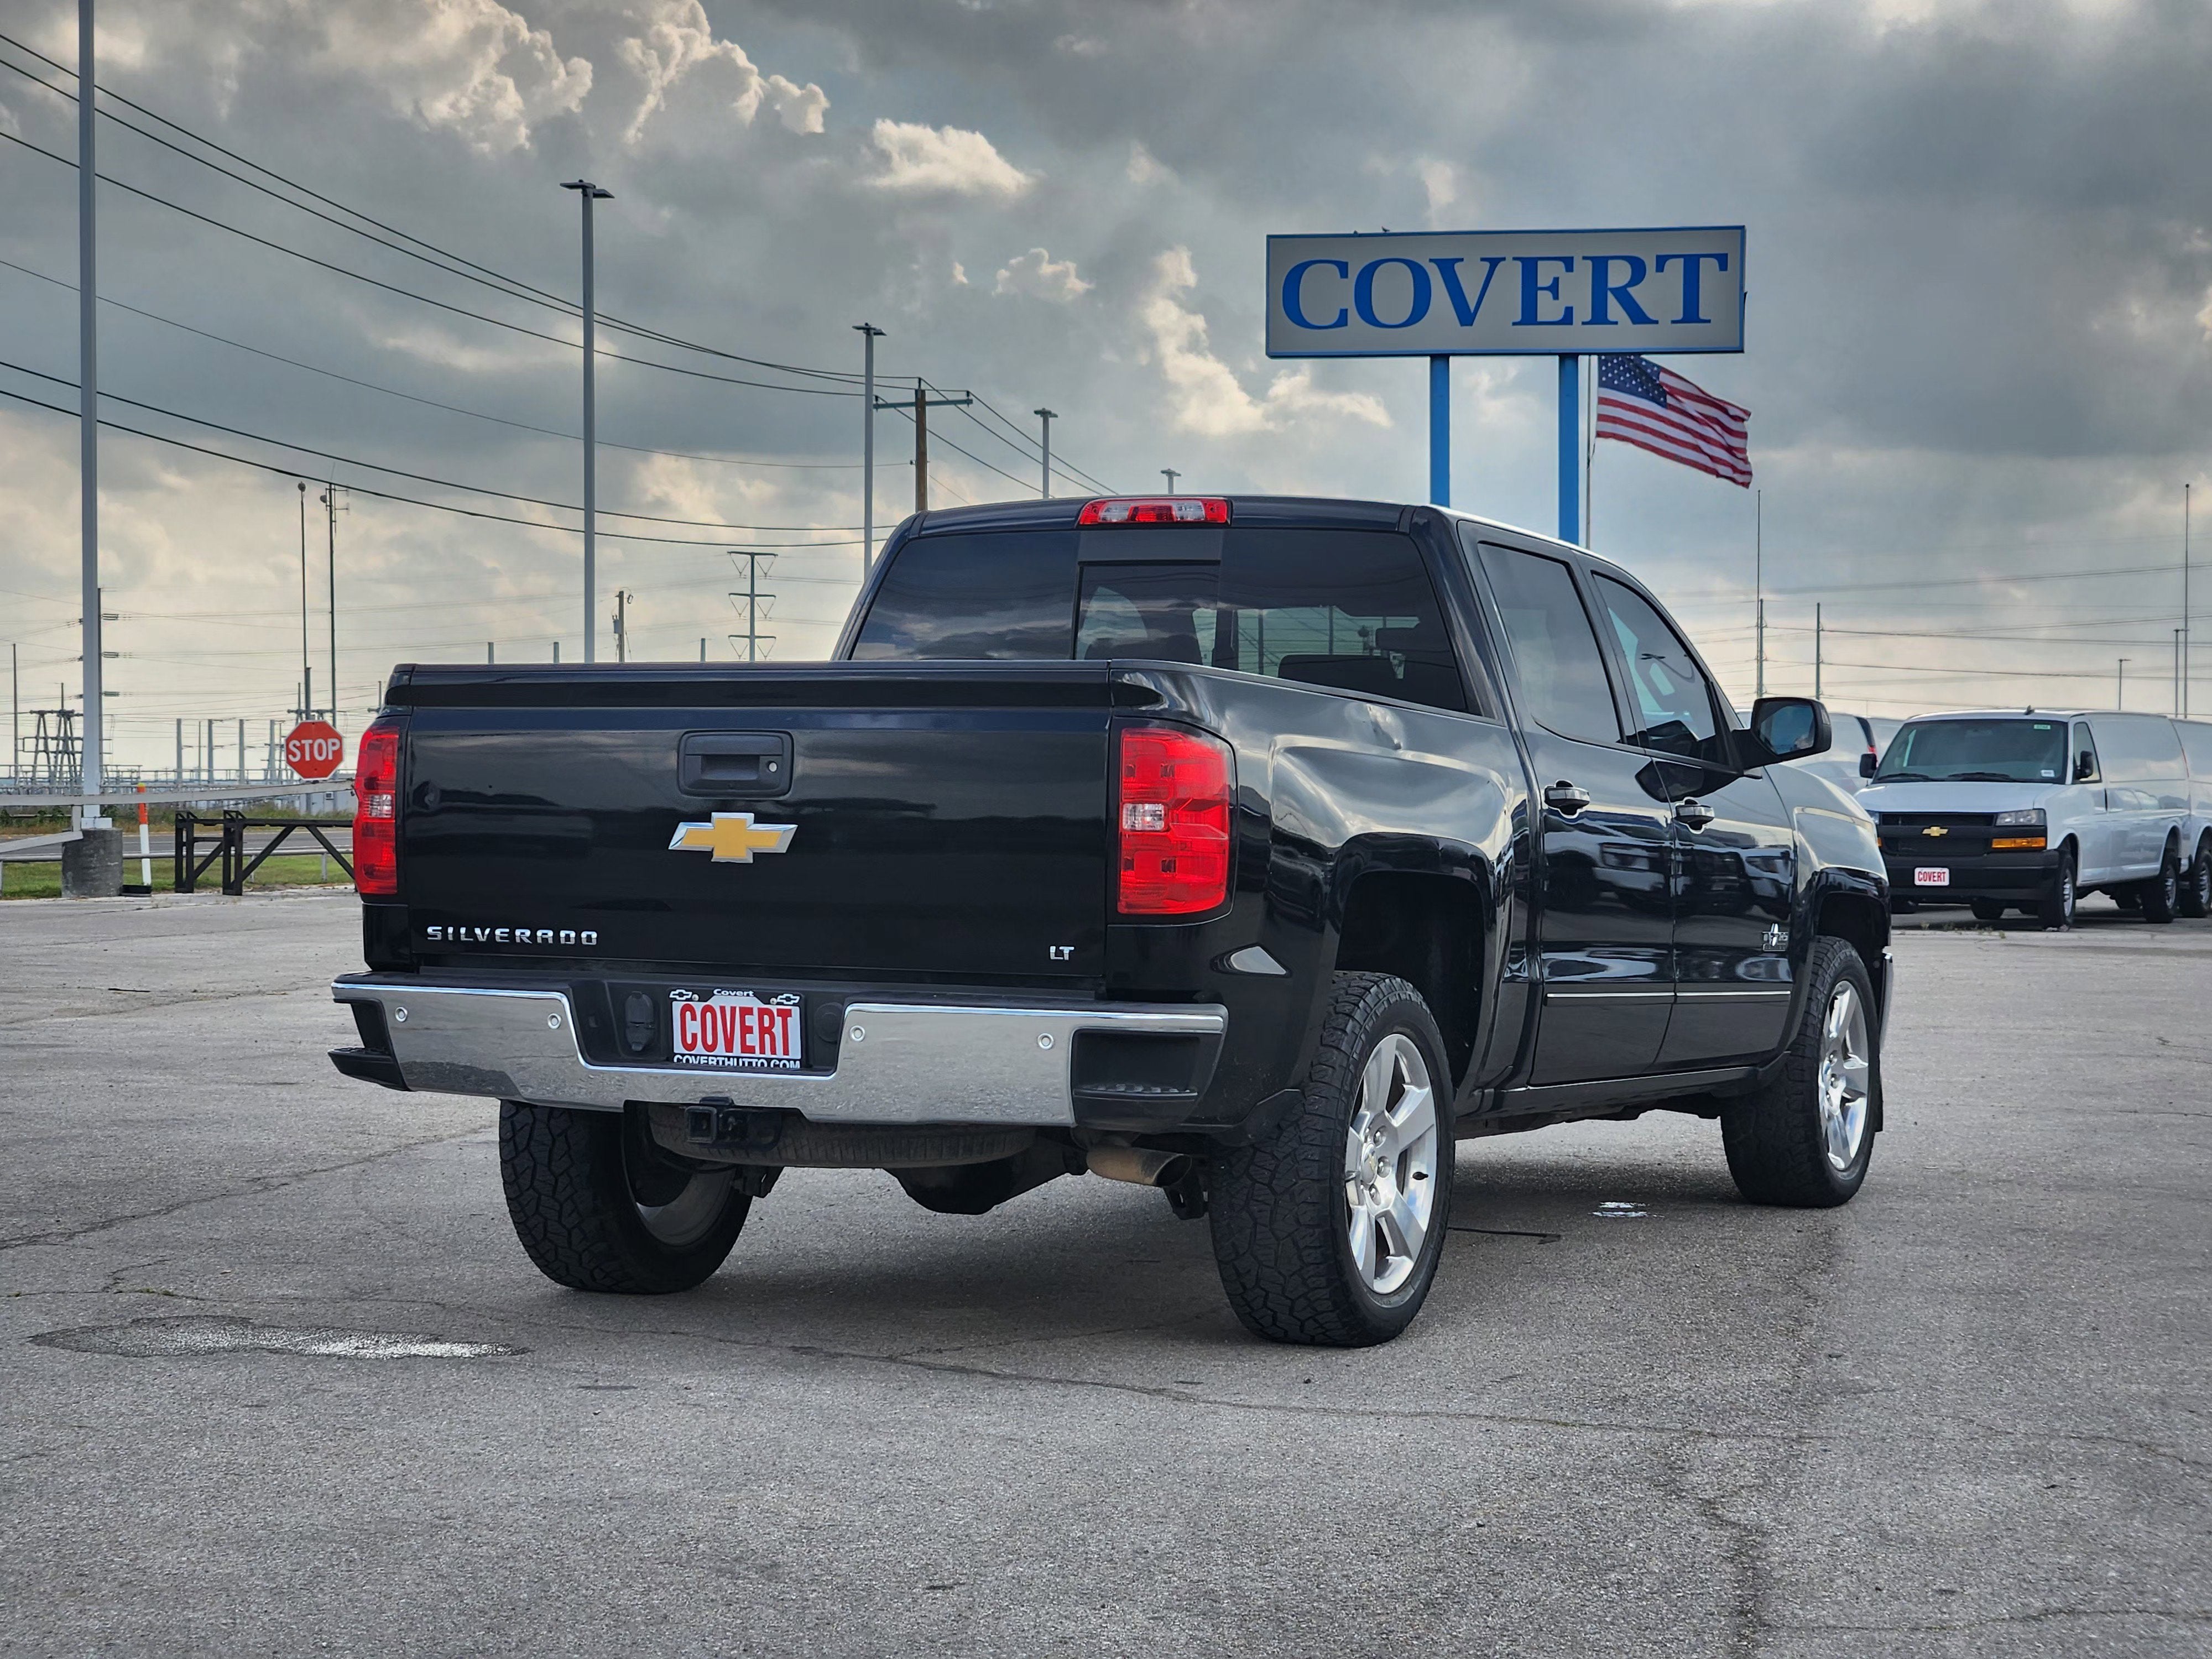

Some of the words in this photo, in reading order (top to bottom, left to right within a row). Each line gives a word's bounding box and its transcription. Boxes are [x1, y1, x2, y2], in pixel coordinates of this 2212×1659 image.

[1282, 253, 1728, 330] COVERT
[288, 738, 341, 762] STOP
[1918, 871, 1946, 882] COVERT
[427, 926, 598, 945] SILVERADO
[1050, 946, 1074, 961] LT
[713, 988, 754, 997] Covert
[680, 1003, 792, 1056] COVERT
